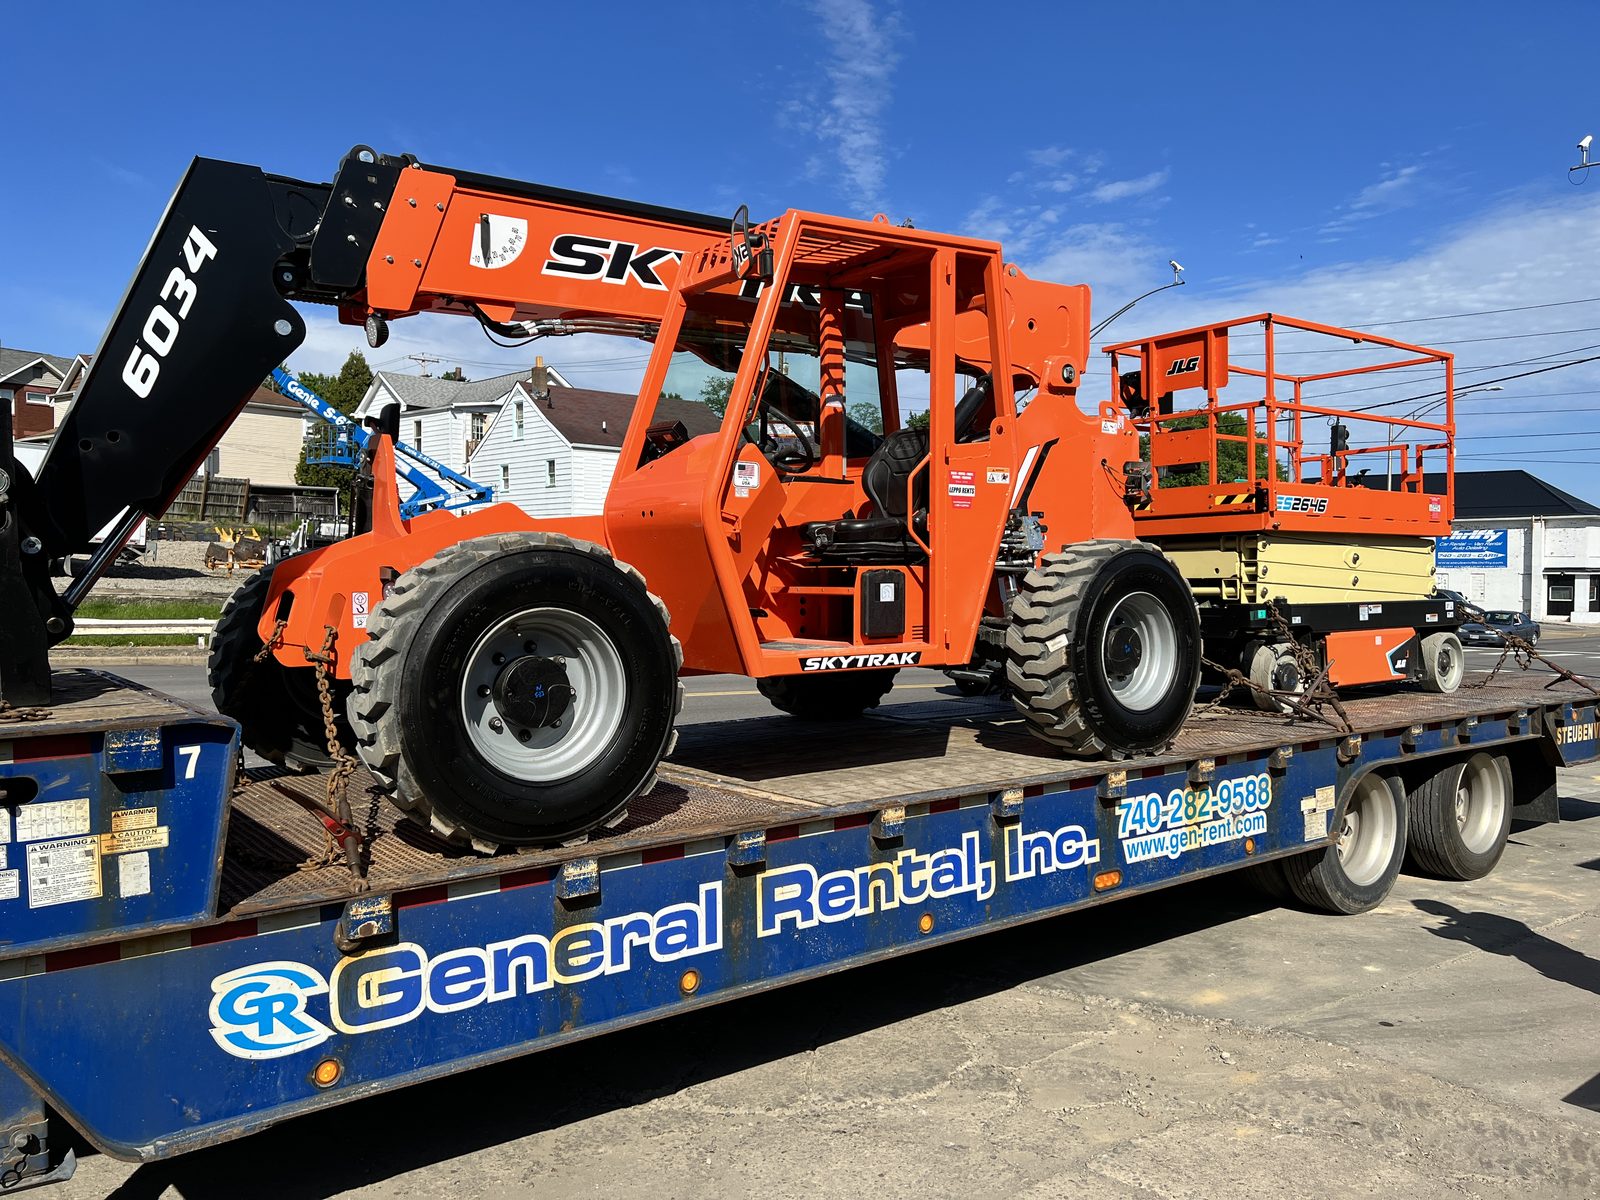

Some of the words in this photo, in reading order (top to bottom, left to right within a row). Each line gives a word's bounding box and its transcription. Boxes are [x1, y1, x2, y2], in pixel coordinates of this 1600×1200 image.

[122, 225, 218, 399] 6034
[1166, 356, 1200, 376] JLG
[287, 381, 320, 410] Genie
[1277, 495, 1329, 513] ES2646
[1442, 530, 1504, 542] hrifty
[804, 652, 917, 671] SKYTRAK
[179, 746, 201, 779] 7
[121, 808, 156, 816] WARNING
[1118, 774, 1271, 836] 740-282-9588
[118, 829, 157, 838] CAUTION
[1126, 813, 1266, 860] www.gen-rent.com
[39, 838, 88, 850] WARNING
[330, 881, 724, 1035] General
[757, 831, 996, 938] Rental,
[1004, 822, 1100, 883] Inc.
